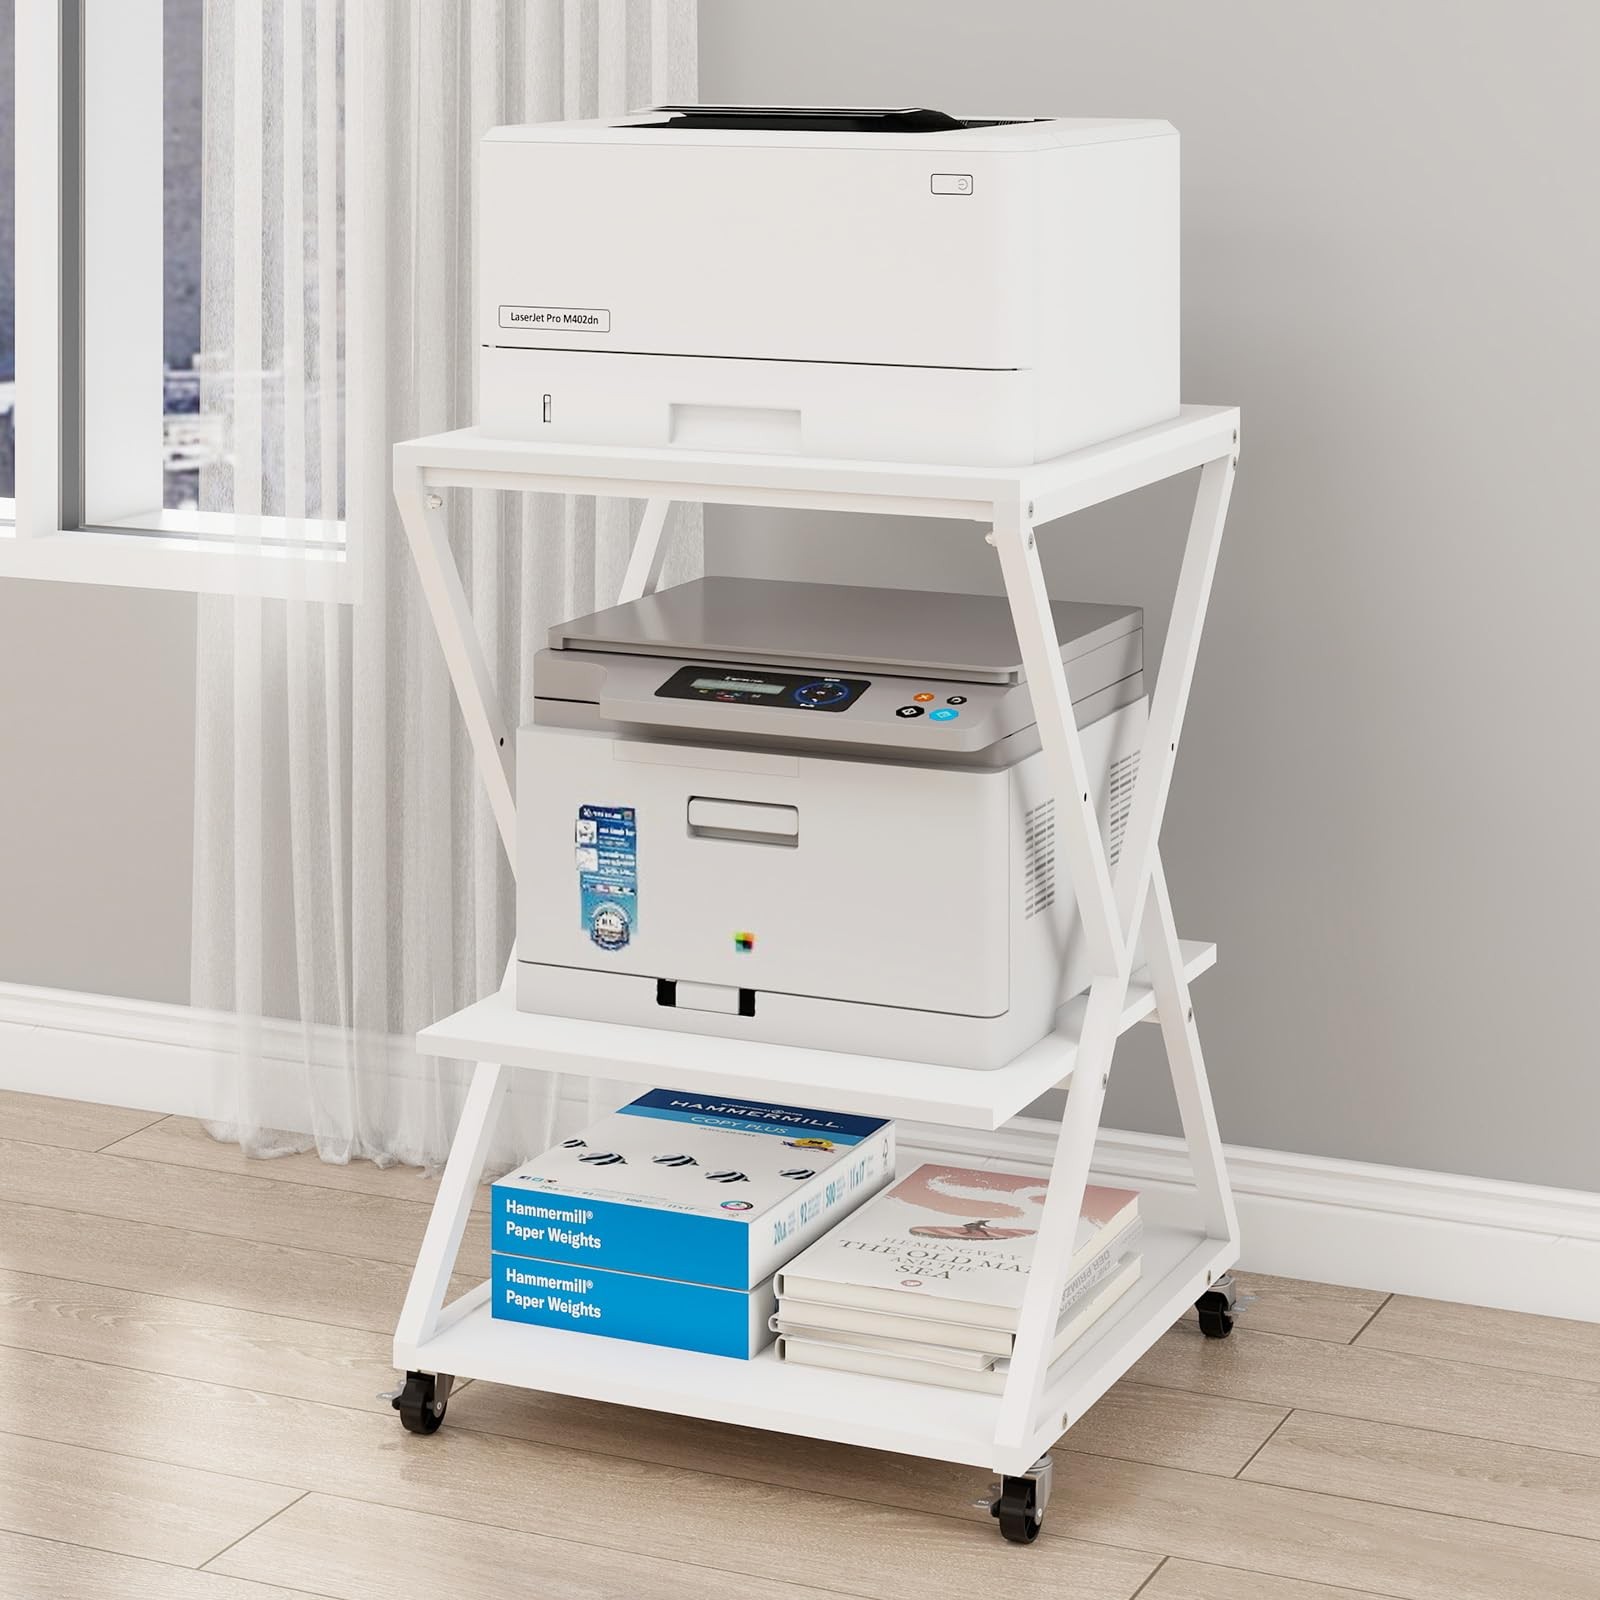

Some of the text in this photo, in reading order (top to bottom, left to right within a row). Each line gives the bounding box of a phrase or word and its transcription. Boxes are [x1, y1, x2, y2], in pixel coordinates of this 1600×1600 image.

[510, 312, 599, 325] LaserJet Pro M402dn
[690, 1116, 744, 1128] COPY
[744, 1123, 788, 1135] PLUS
[506, 1221, 601, 1249] Paper Weights
[839, 1239, 898, 1255] THE
[906, 1249, 972, 1265] OLD
[882, 1237, 1024, 1261] HEMINGWAY
[891, 1257, 977, 1272] AND THE
[895, 1265, 951, 1280] SEA
[506, 1289, 601, 1318] Paper Weights
